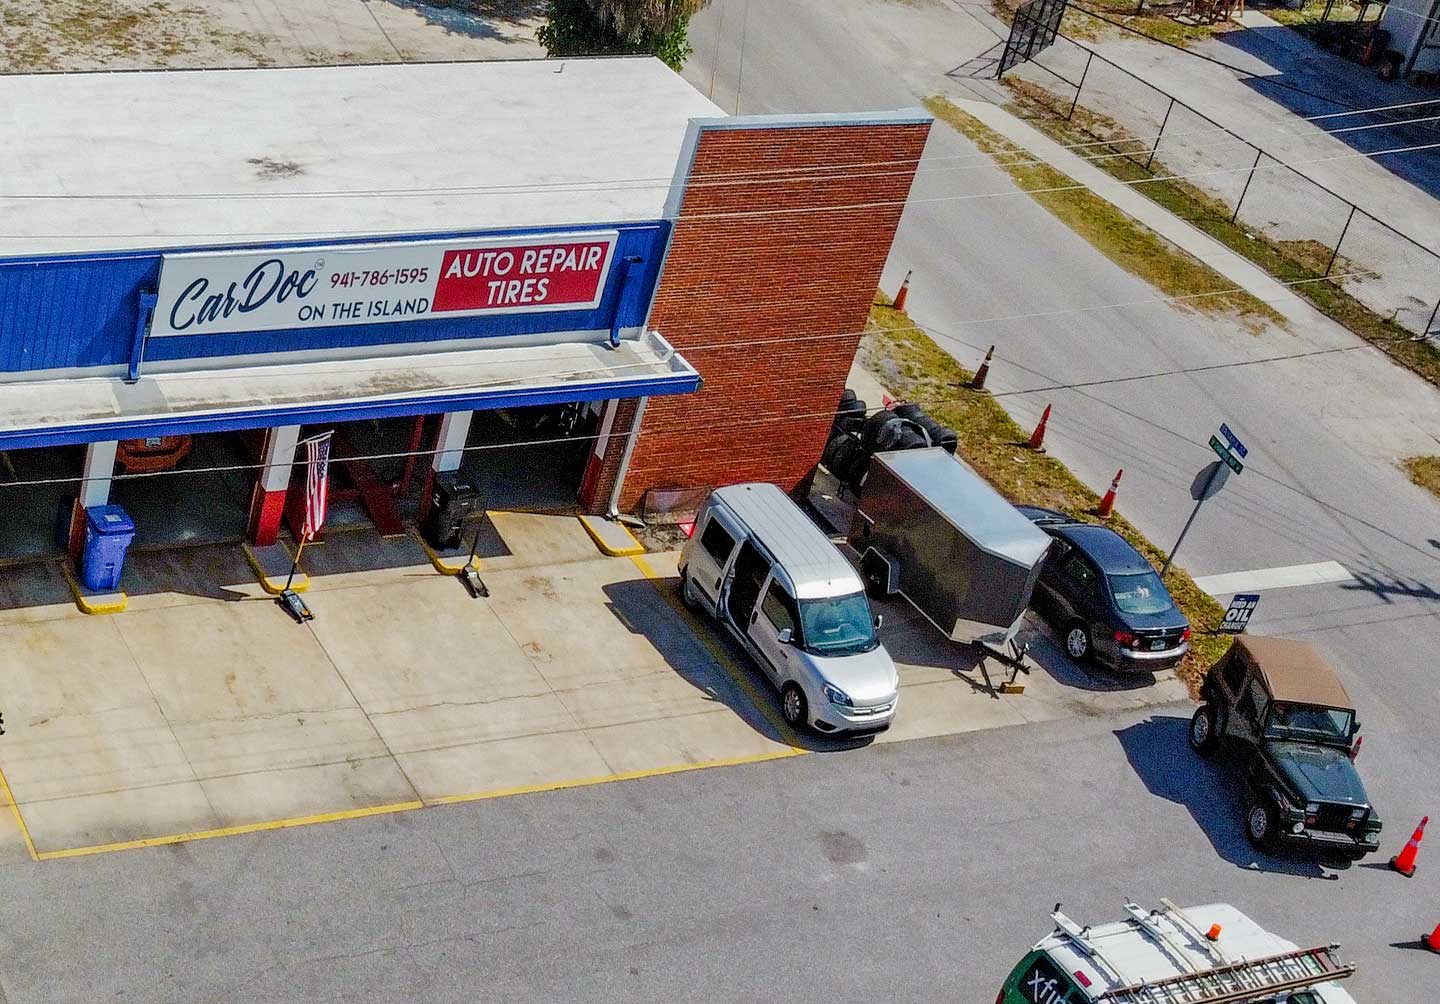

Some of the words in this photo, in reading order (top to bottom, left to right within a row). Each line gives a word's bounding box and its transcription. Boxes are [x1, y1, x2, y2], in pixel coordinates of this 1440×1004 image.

[445, 251, 514, 279] AUTO
[520, 246, 602, 275] REPAIR
[330, 267, 429, 289] 941-786-1595
[487, 278, 550, 305] TIRES
[298, 304, 326, 321] ON
[332, 302, 364, 319] THE
[367, 298, 429, 317] ISLAND
[1225, 608, 1251, 622] OIL
